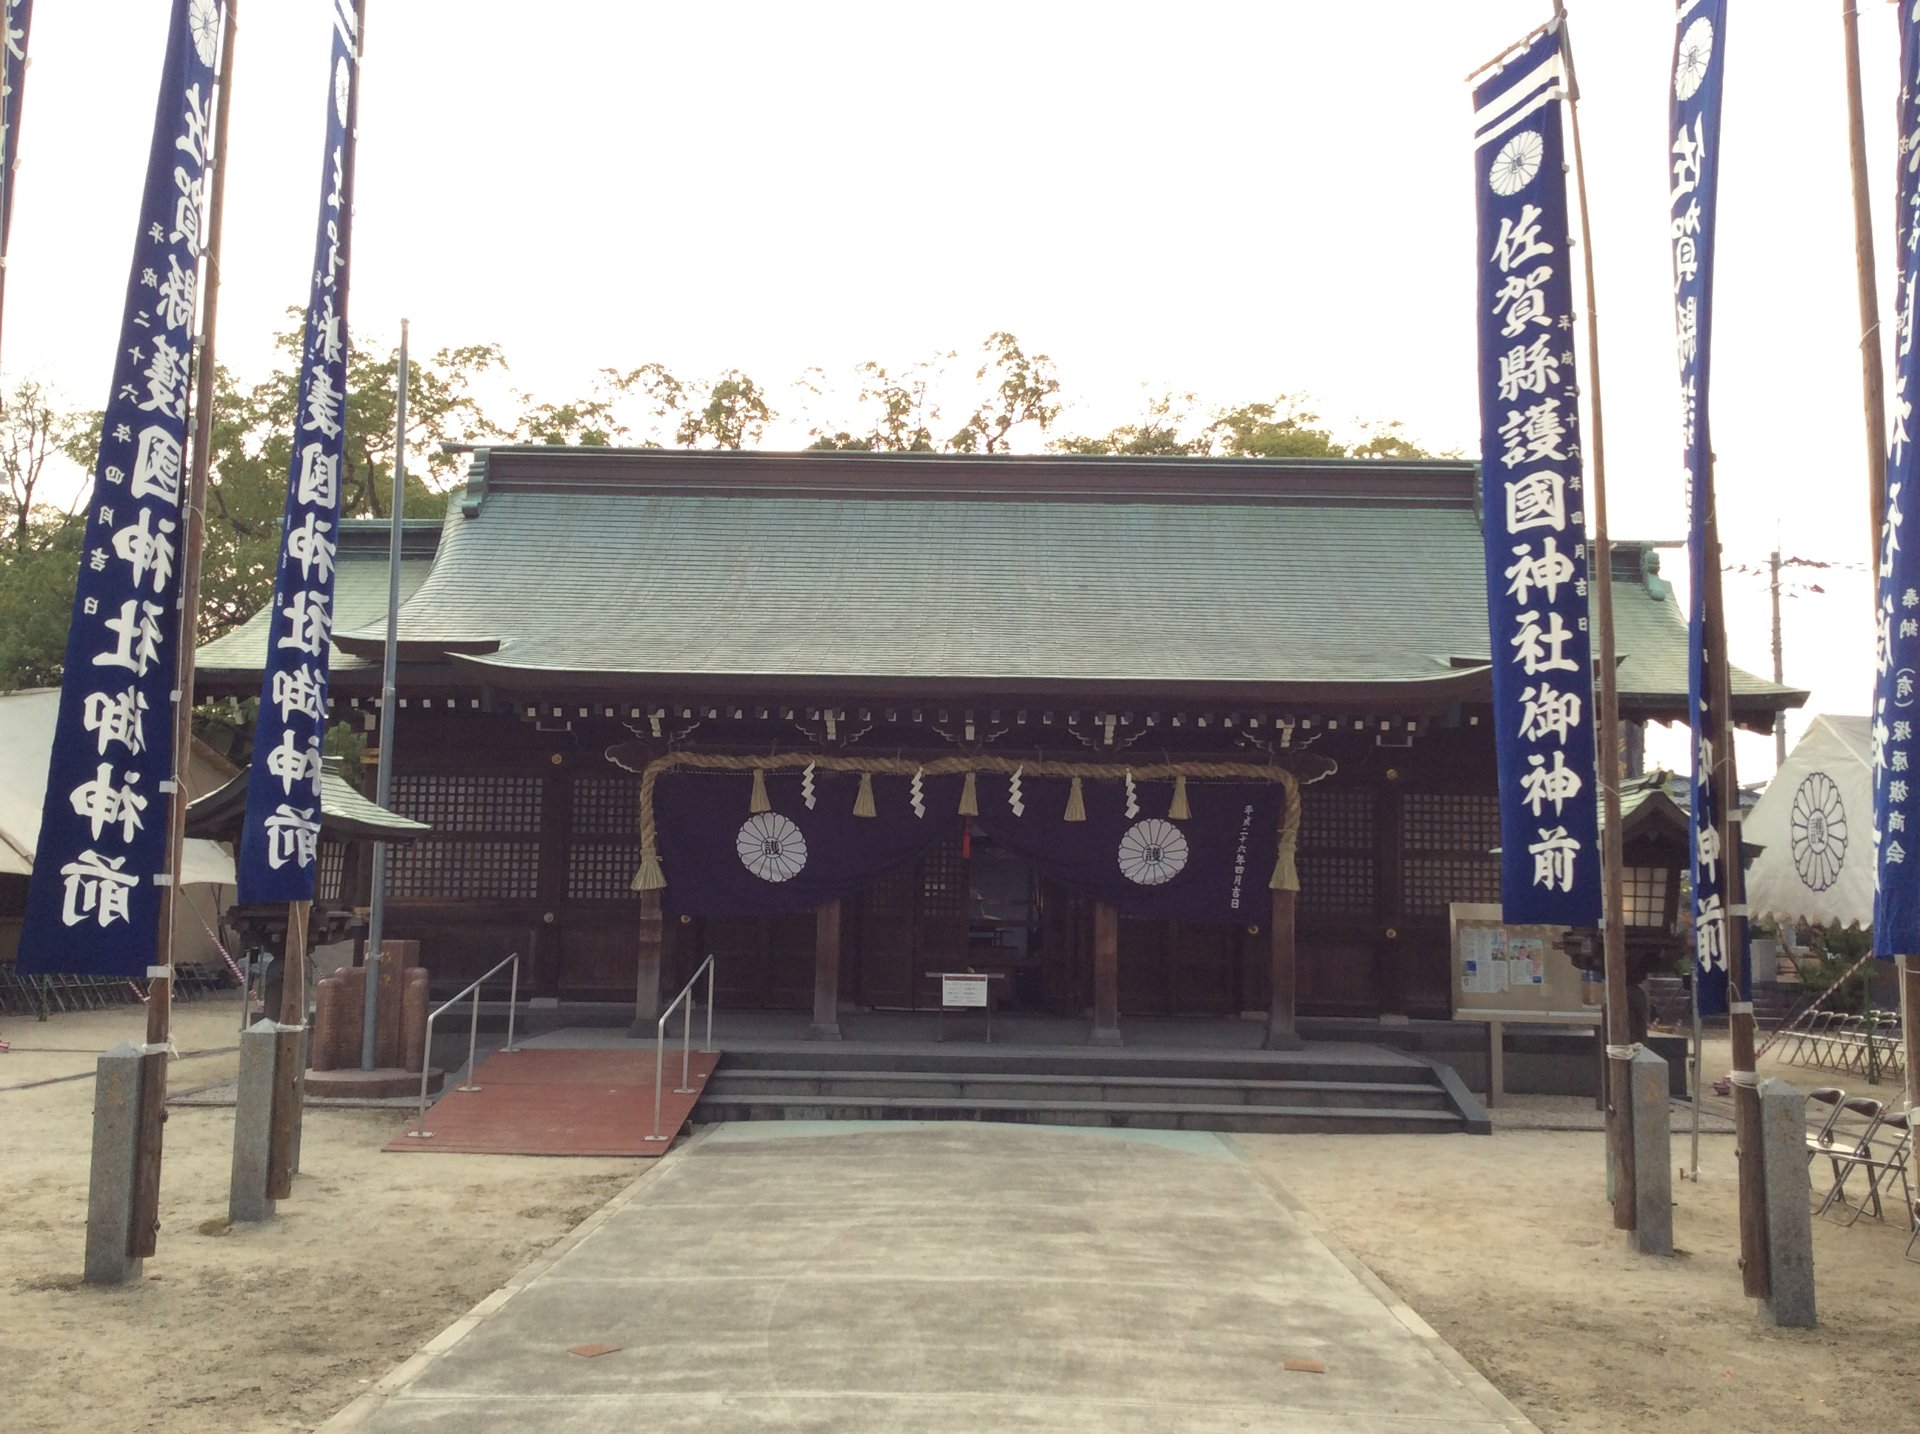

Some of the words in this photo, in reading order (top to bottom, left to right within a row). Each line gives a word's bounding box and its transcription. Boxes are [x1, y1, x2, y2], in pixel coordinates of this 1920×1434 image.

[1490, 203, 1582, 893] 佐賀縣護國神社御神前
[1557, 315, 1588, 633] 平成二十六年四月吉日
[1231, 805, 1254, 909] 平成二十六年四月吉日
